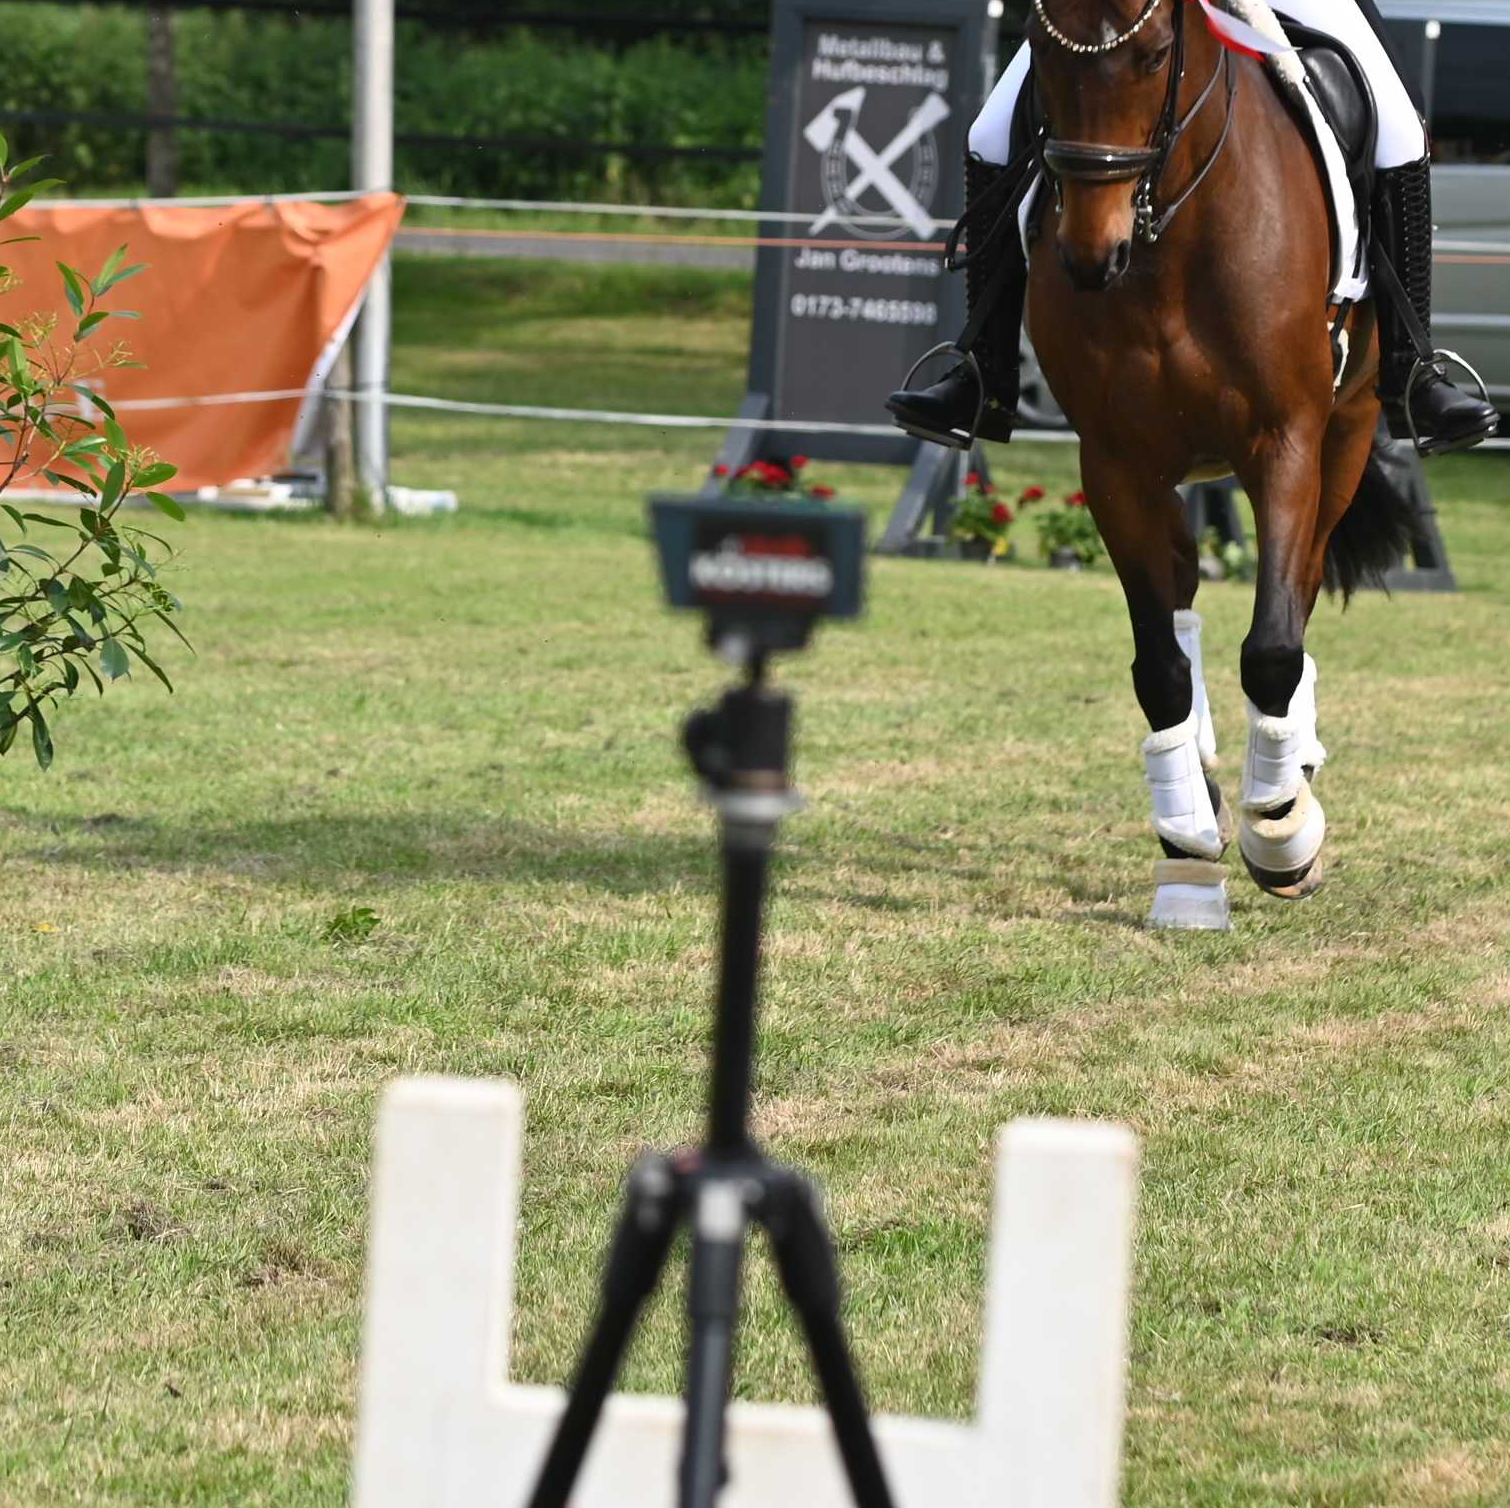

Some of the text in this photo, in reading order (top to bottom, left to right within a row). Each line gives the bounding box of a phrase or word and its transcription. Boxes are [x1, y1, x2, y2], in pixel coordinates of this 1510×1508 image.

[818, 34, 945, 63] Metallbau &
[811, 58, 949, 91] Hufbeschlag
[795, 247, 836, 269] Jan
